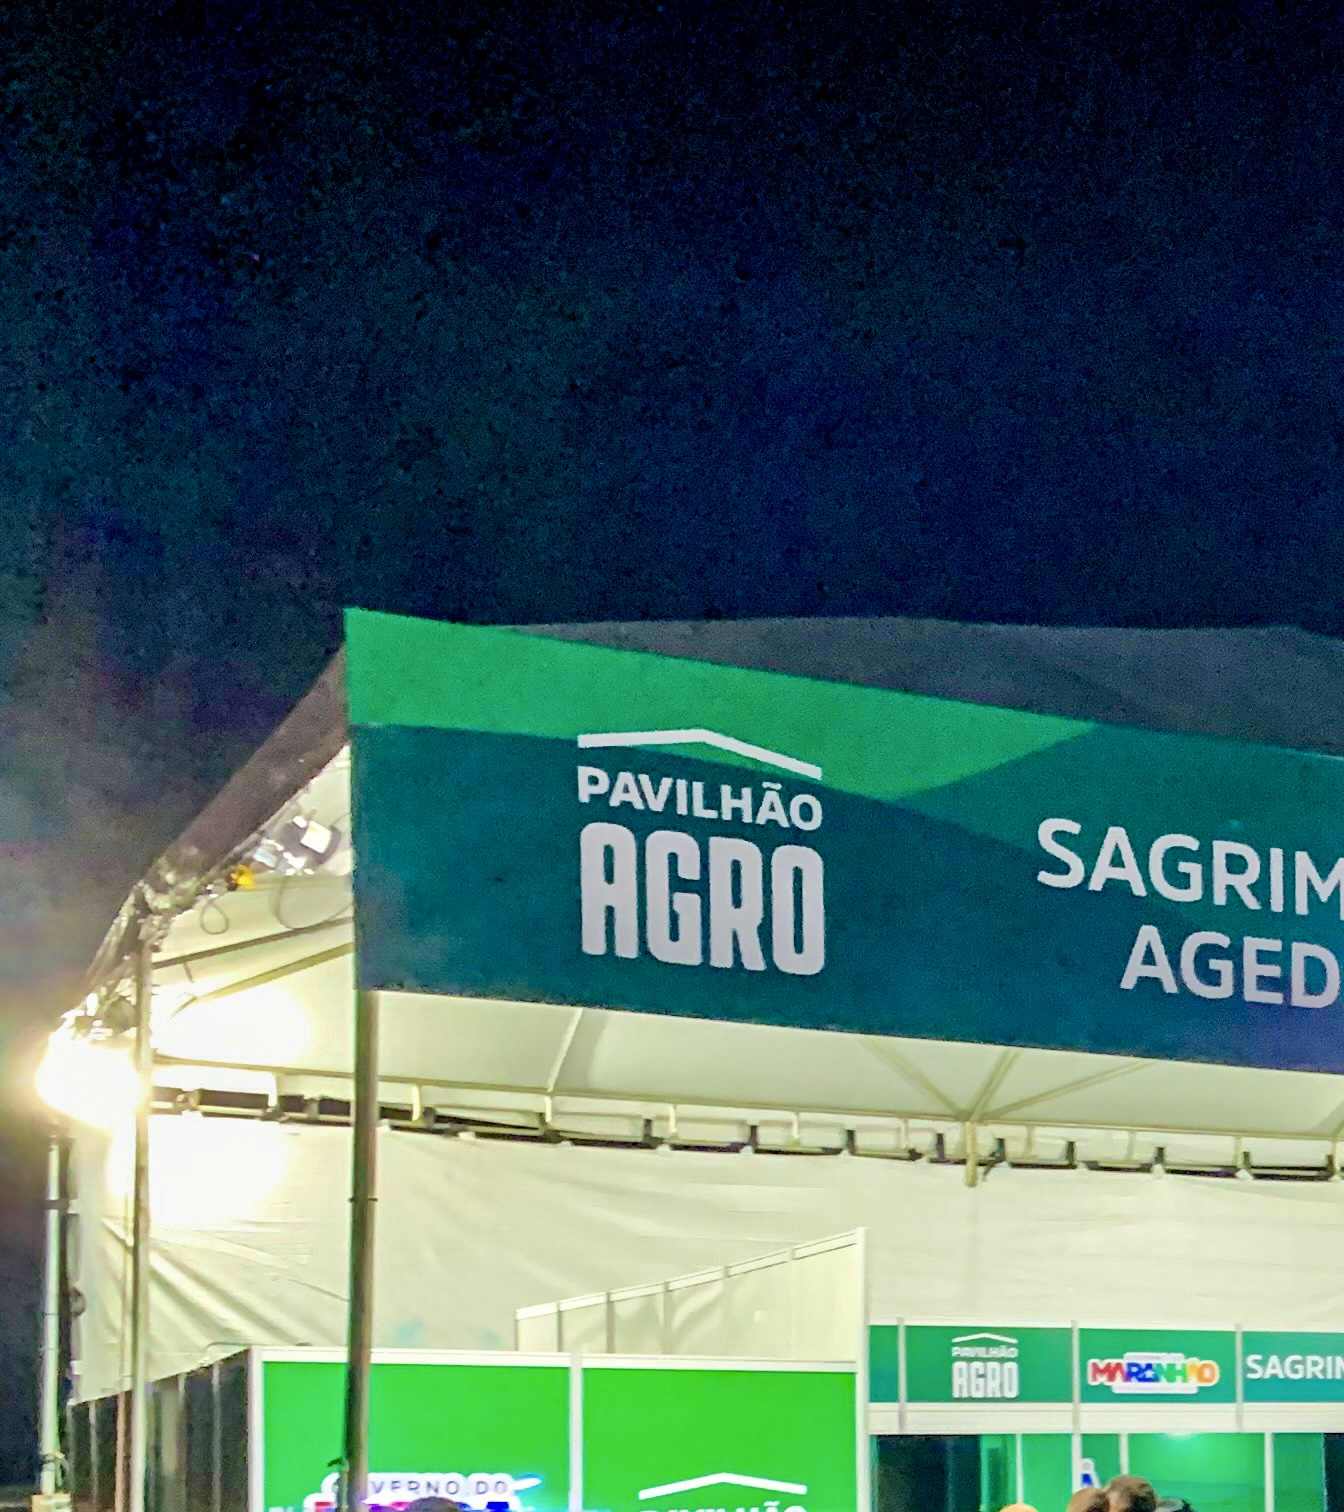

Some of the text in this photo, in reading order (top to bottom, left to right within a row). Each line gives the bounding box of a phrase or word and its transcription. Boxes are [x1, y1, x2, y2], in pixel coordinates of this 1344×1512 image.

[577, 766, 823, 830] PAVILHÃO
[580, 822, 825, 975] AGRO
[1120, 924, 1341, 1009] AGED
[952, 1361, 1019, 1399] AGRO
[332, 1480, 509, 1496] VERNO DO
